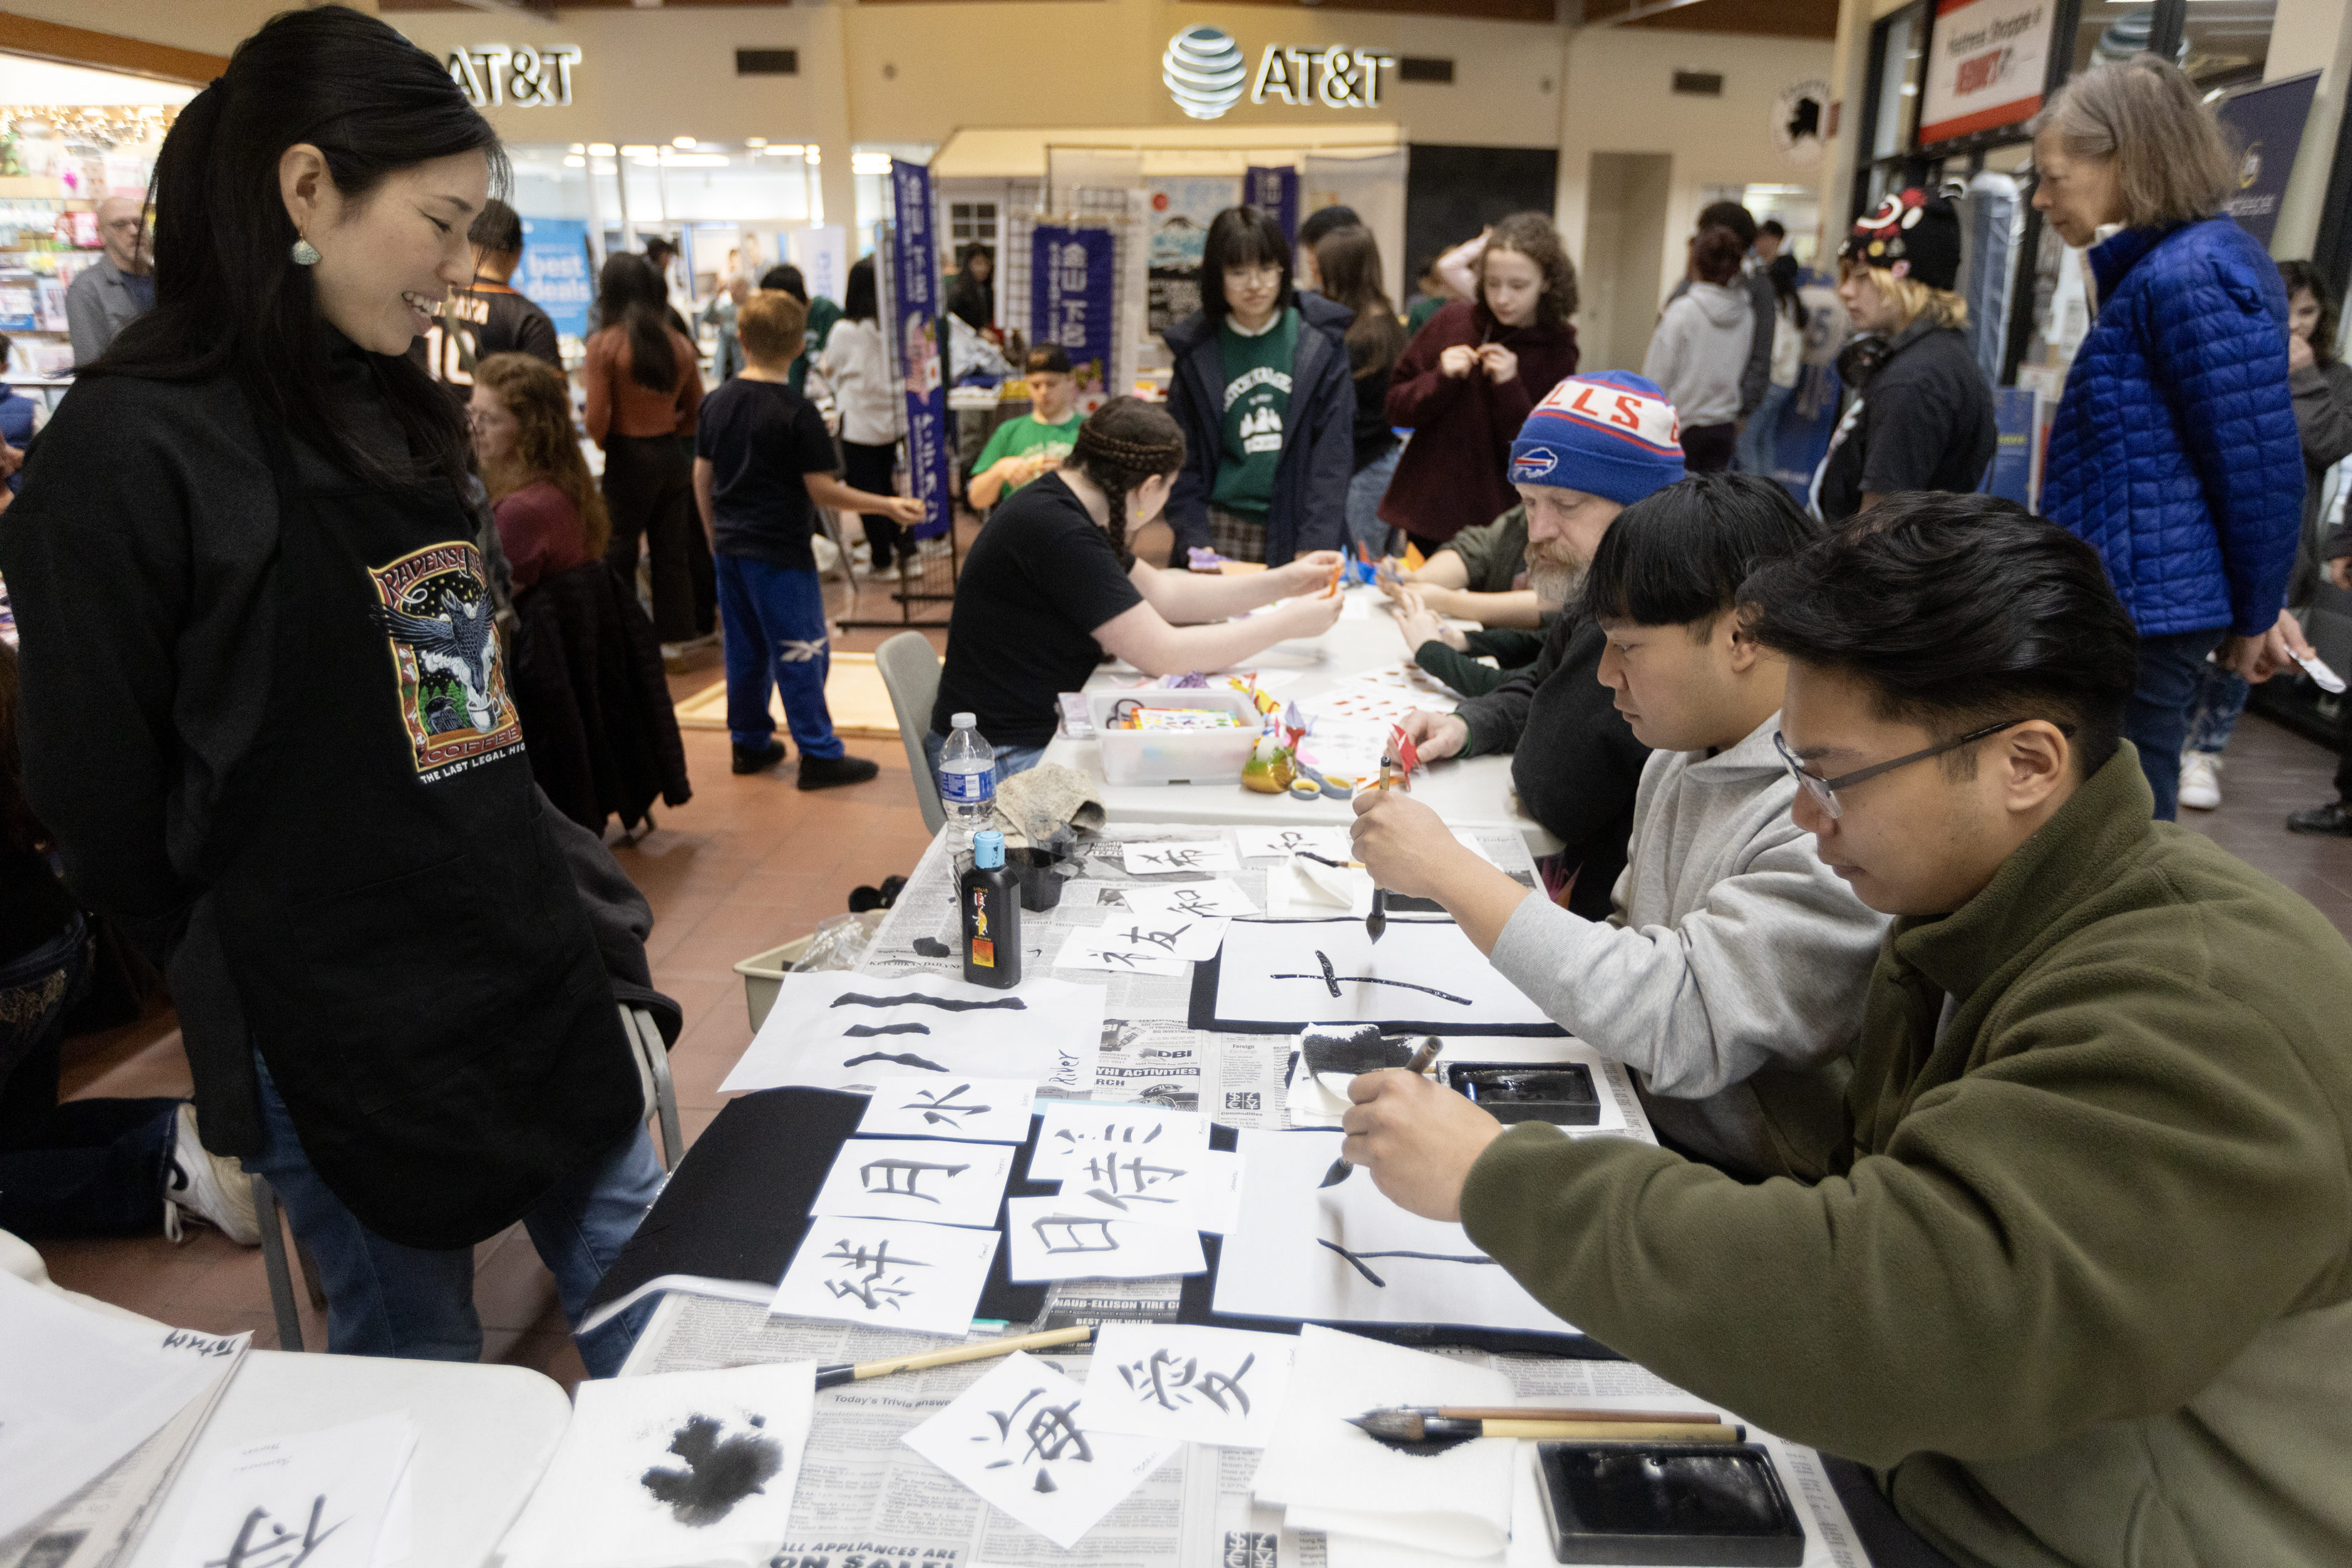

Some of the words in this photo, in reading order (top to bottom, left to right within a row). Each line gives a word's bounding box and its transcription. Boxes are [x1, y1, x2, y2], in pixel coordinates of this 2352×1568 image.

[448, 43, 582, 108] AT&T
[1251, 43, 1397, 108] AT&T
[421, 770, 440, 785] THE
[443, 761, 468, 778] LAST
[471, 749, 506, 768] LEGAL
[428, 728, 519, 763] COFFEE
[1117, 923, 1193, 954] 友
[899, 1083, 992, 1131] 水
[860, 1157, 971, 1205] 月
[1082, 1151, 1189, 1212] 侍
[1031, 1216, 1120, 1255] 日
[821, 1238, 937, 1311] 絆
[1056, 1299, 1138, 1309] HAUB-ELLISON
[1140, 1301, 1165, 1309] TIRE
[835, 1394, 877, 1405] Today's
[882, 1397, 912, 1408] Trivia
[915, 1398, 954, 1407] answe
[1115, 1347, 1256, 1420] 愛
[969, 1386, 1094, 1493] 海
[811, 1541, 919, 1557] APPLIANCES
[923, 1547, 959, 1559] ARE
